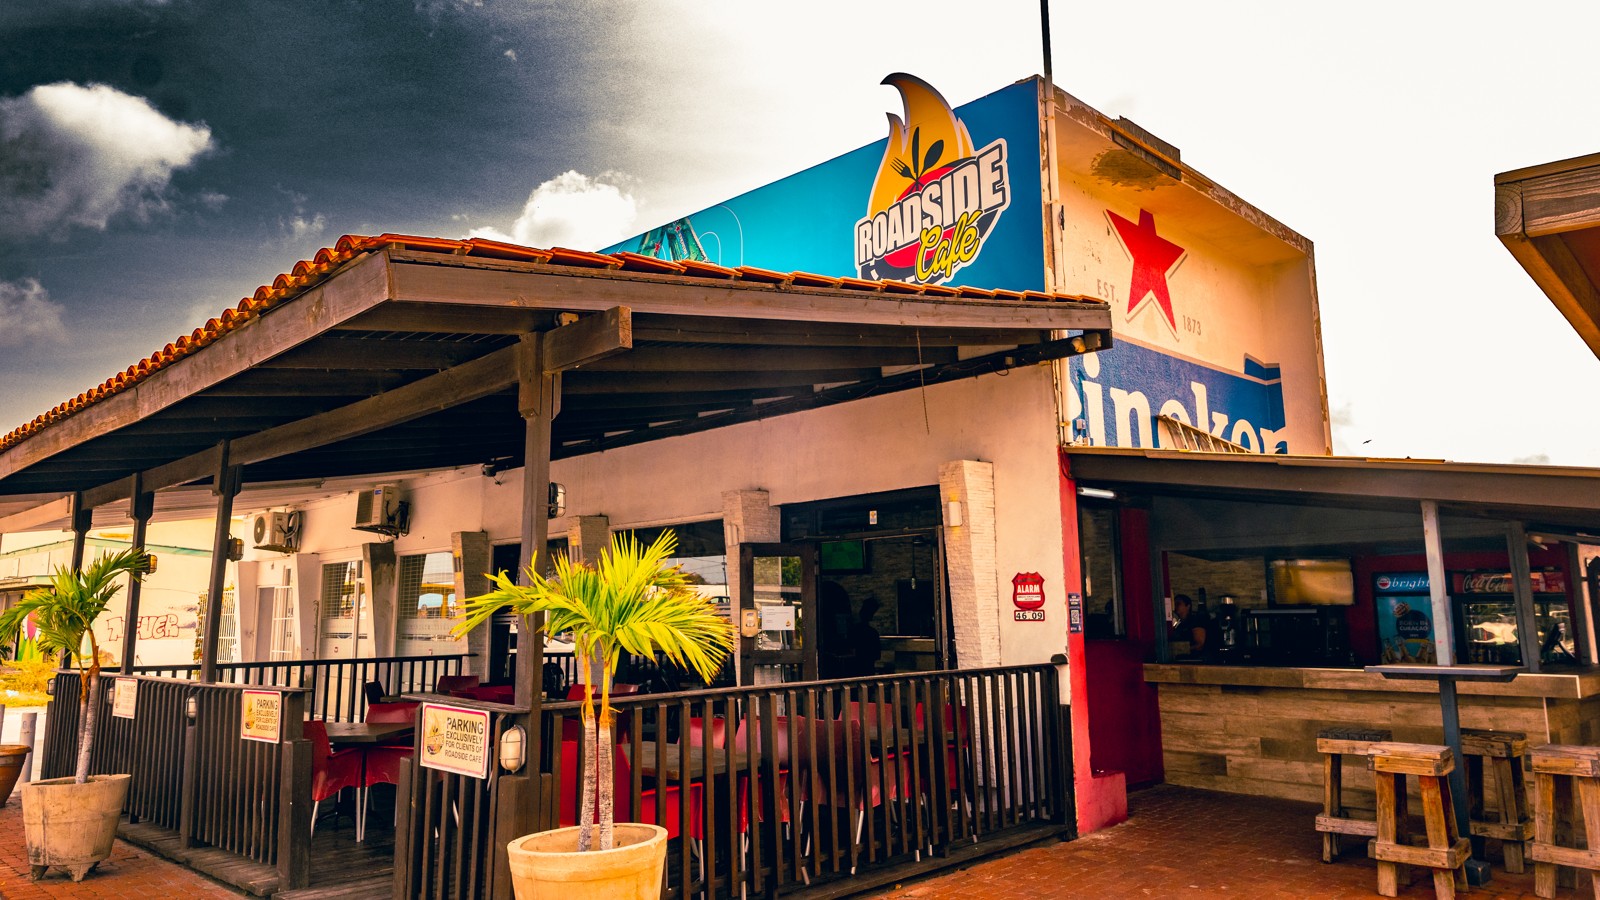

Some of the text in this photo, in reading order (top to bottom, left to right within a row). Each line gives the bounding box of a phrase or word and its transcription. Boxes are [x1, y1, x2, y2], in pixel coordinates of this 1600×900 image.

[858, 143, 1006, 266] ROADSIDE
[915, 210, 983, 281] Café
[1096, 279, 1119, 303] EST.
[1182, 315, 1202, 336] 1873
[1017, 584, 1040, 594] ALARM
[106, 613, 180, 641] NVER
[256, 699, 278, 710] PARKING
[447, 717, 484, 734] PARKING
[446, 730, 483, 745] EXCLUSIVELY
[446, 740, 454, 748] FOR
[456, 742, 475, 752] CLIENTS
[445, 750, 468, 761] ROADSIDE
